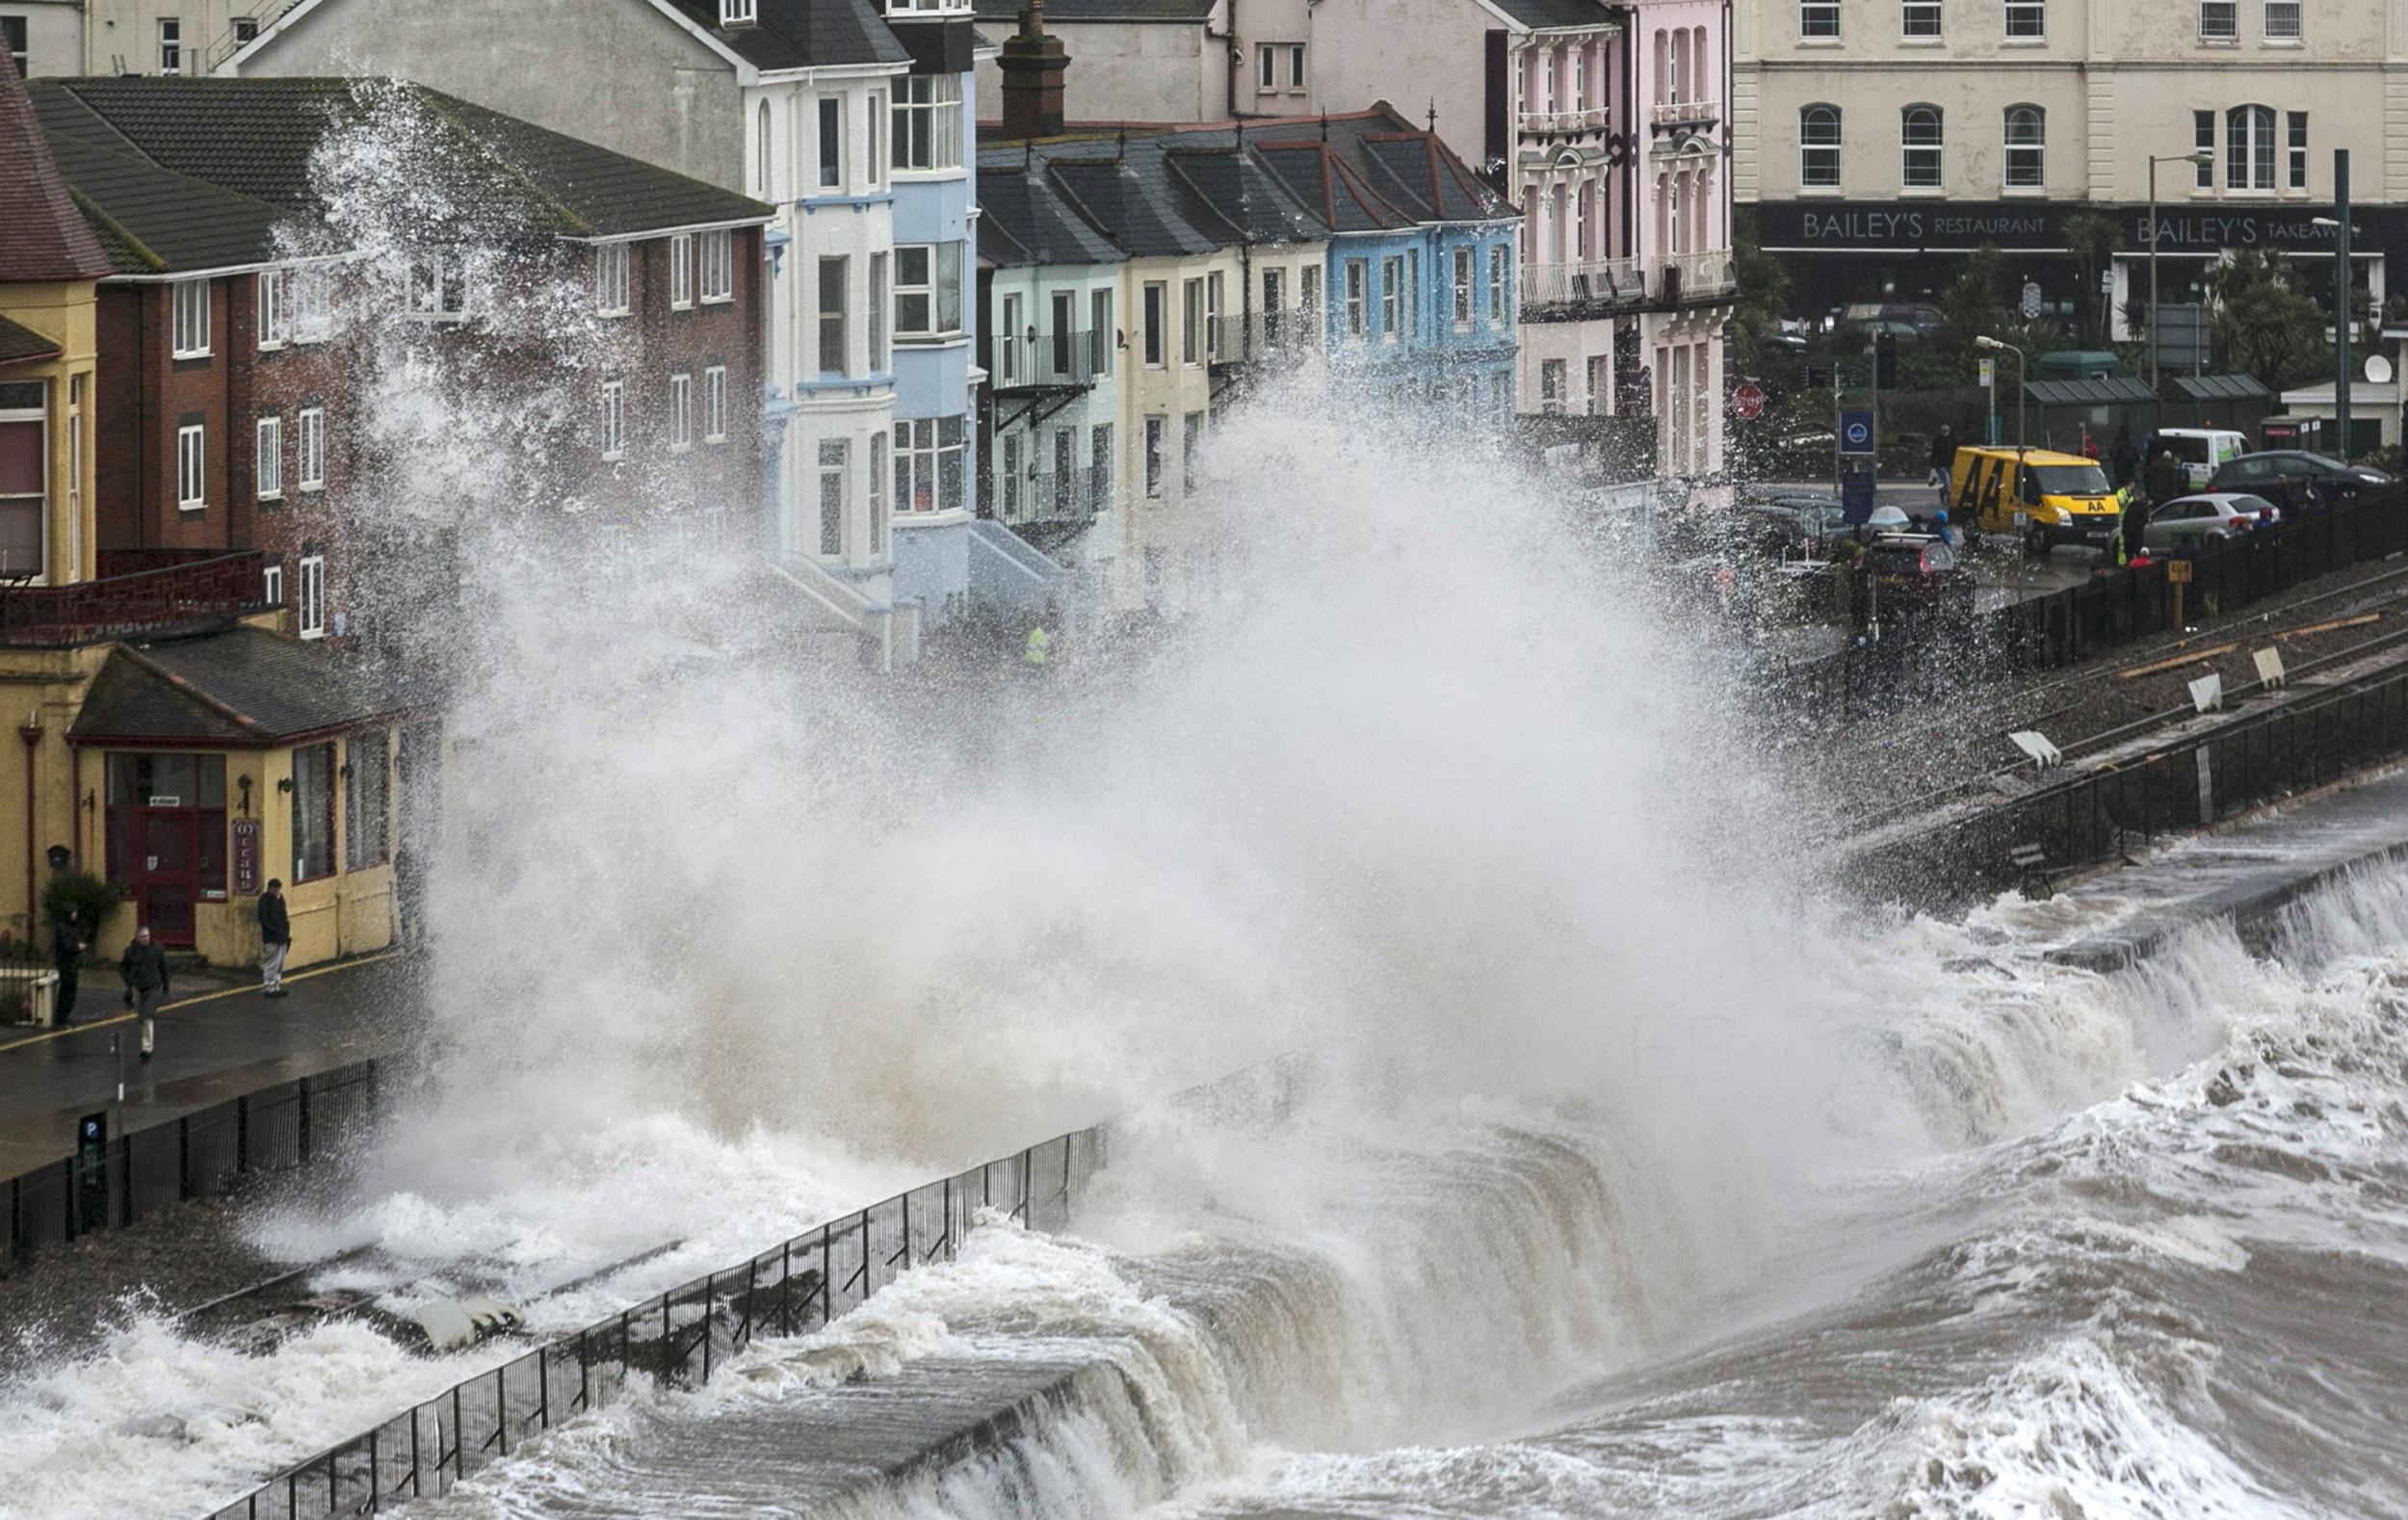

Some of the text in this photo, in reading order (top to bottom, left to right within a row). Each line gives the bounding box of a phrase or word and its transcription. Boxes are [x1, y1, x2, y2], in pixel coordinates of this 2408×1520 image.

[1804, 213, 2045, 238] BAILEY'S RESTAURANT
[2137, 217, 2361, 243] BAILEY'S TAKEAWY
[1735, 396, 1762, 406] STOP
[1958, 454, 2005, 521] AA
[2087, 501, 2107, 511] AA
[87, 1121, 97, 1136] P
